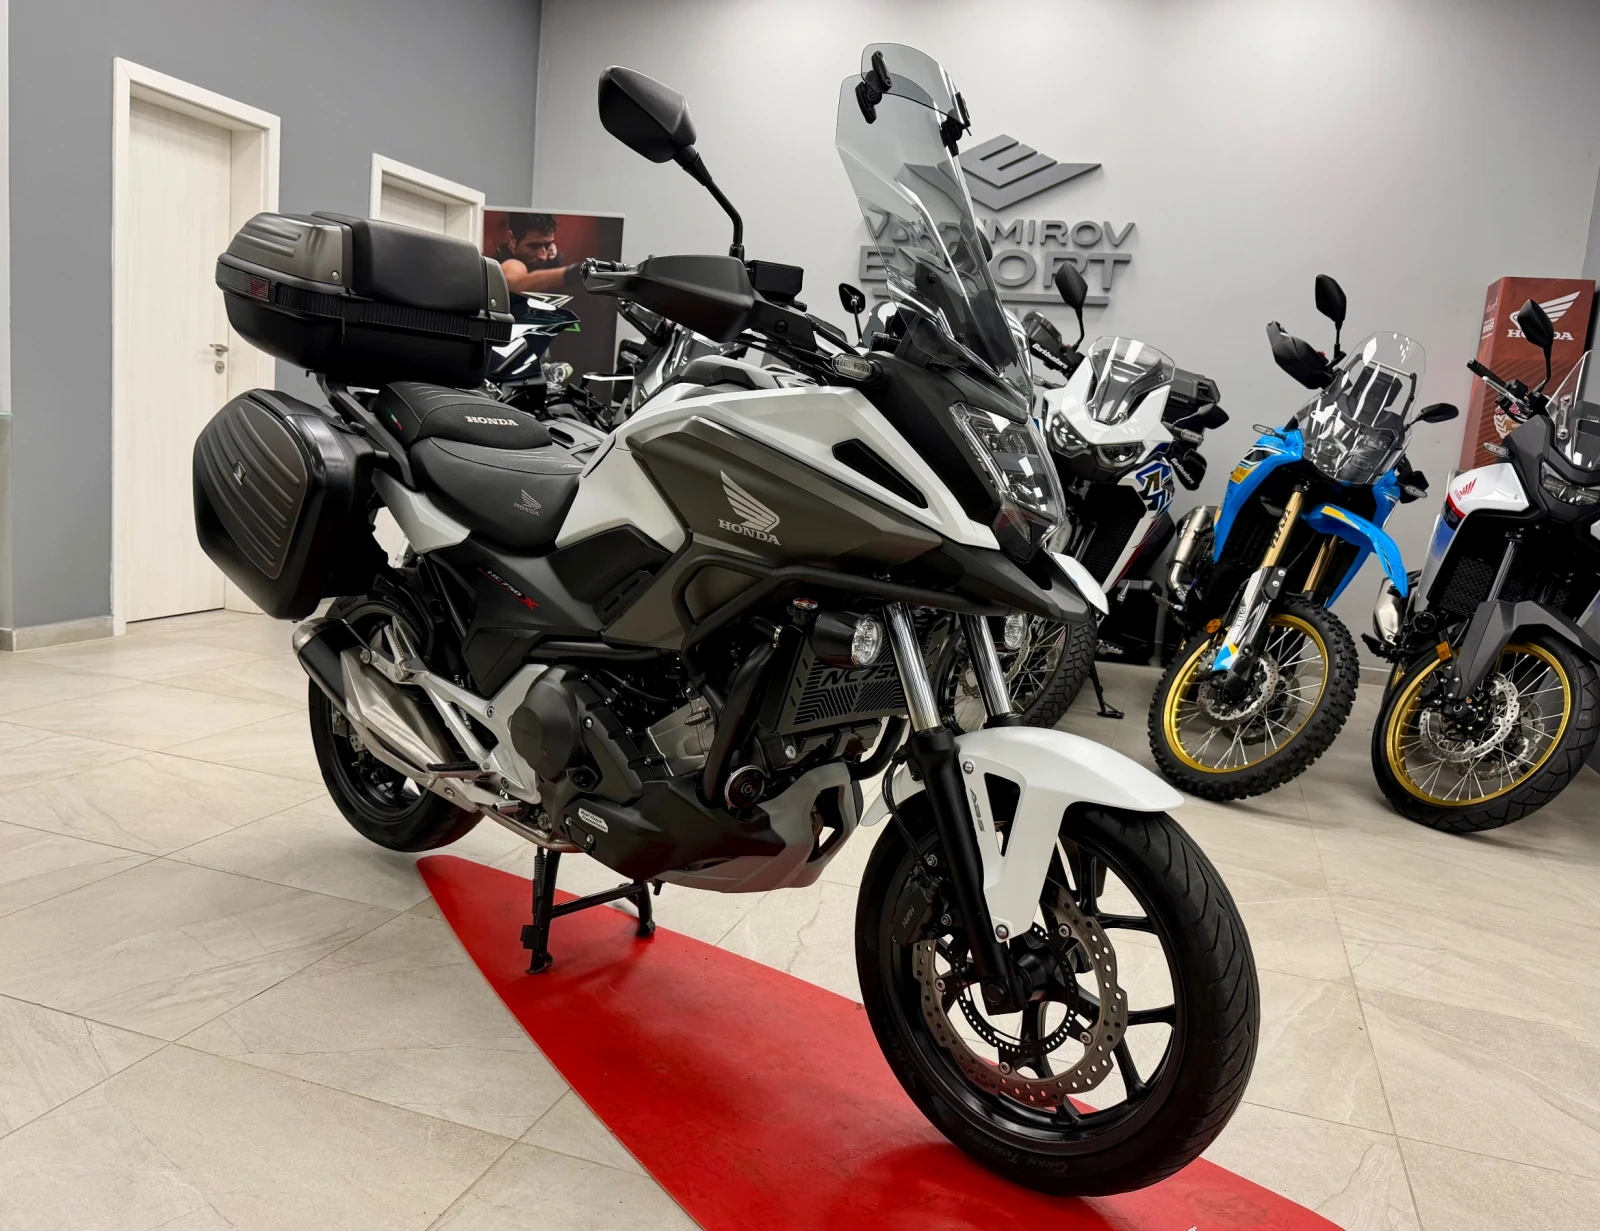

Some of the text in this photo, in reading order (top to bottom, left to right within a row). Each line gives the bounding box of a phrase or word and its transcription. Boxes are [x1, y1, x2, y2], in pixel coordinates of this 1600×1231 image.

[465, 415, 519, 427] HONDA
[513, 502, 540, 516] HONDA
[718, 518, 781, 546] HONDA
[969, 787, 986, 832] ABS
